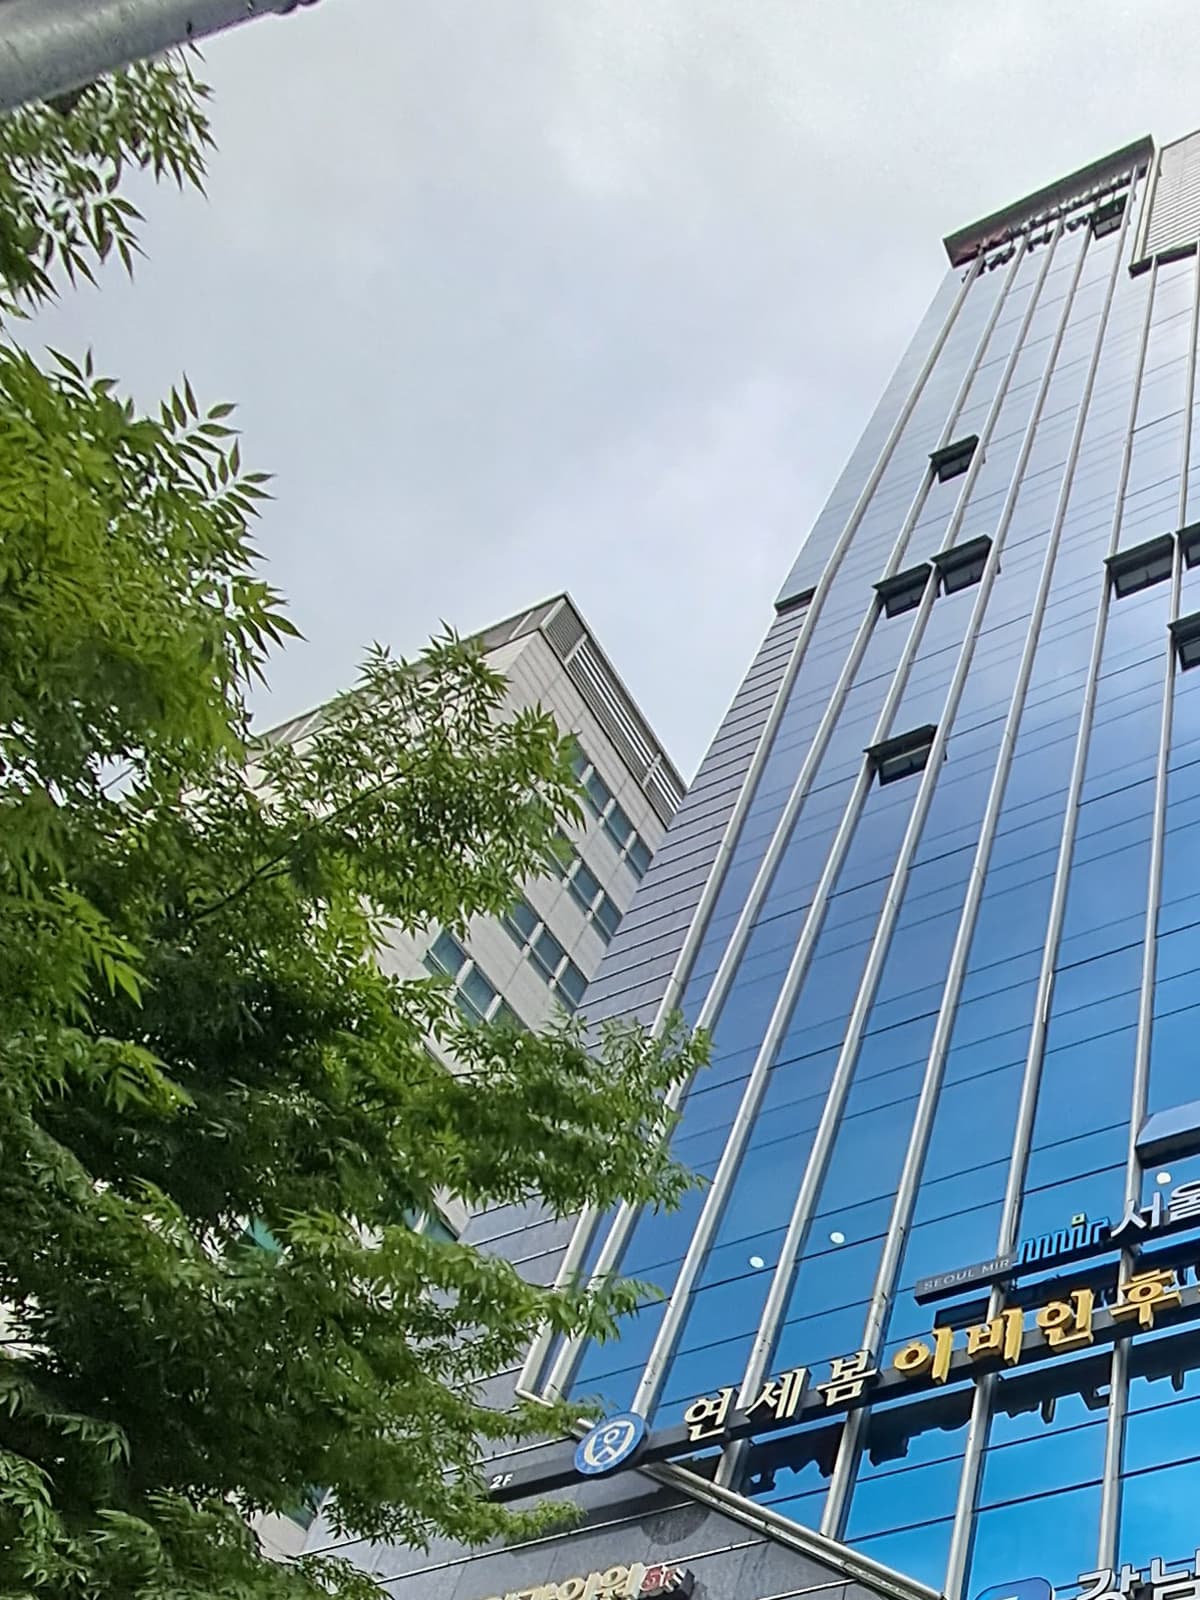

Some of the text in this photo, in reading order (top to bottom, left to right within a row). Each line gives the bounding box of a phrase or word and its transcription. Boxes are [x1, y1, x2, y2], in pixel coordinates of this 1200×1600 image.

[923, 1257, 1010, 1290] SEOUL MIR
[684, 1349, 881, 1442] 연세봄
[490, 1472, 512, 1490] 2F
